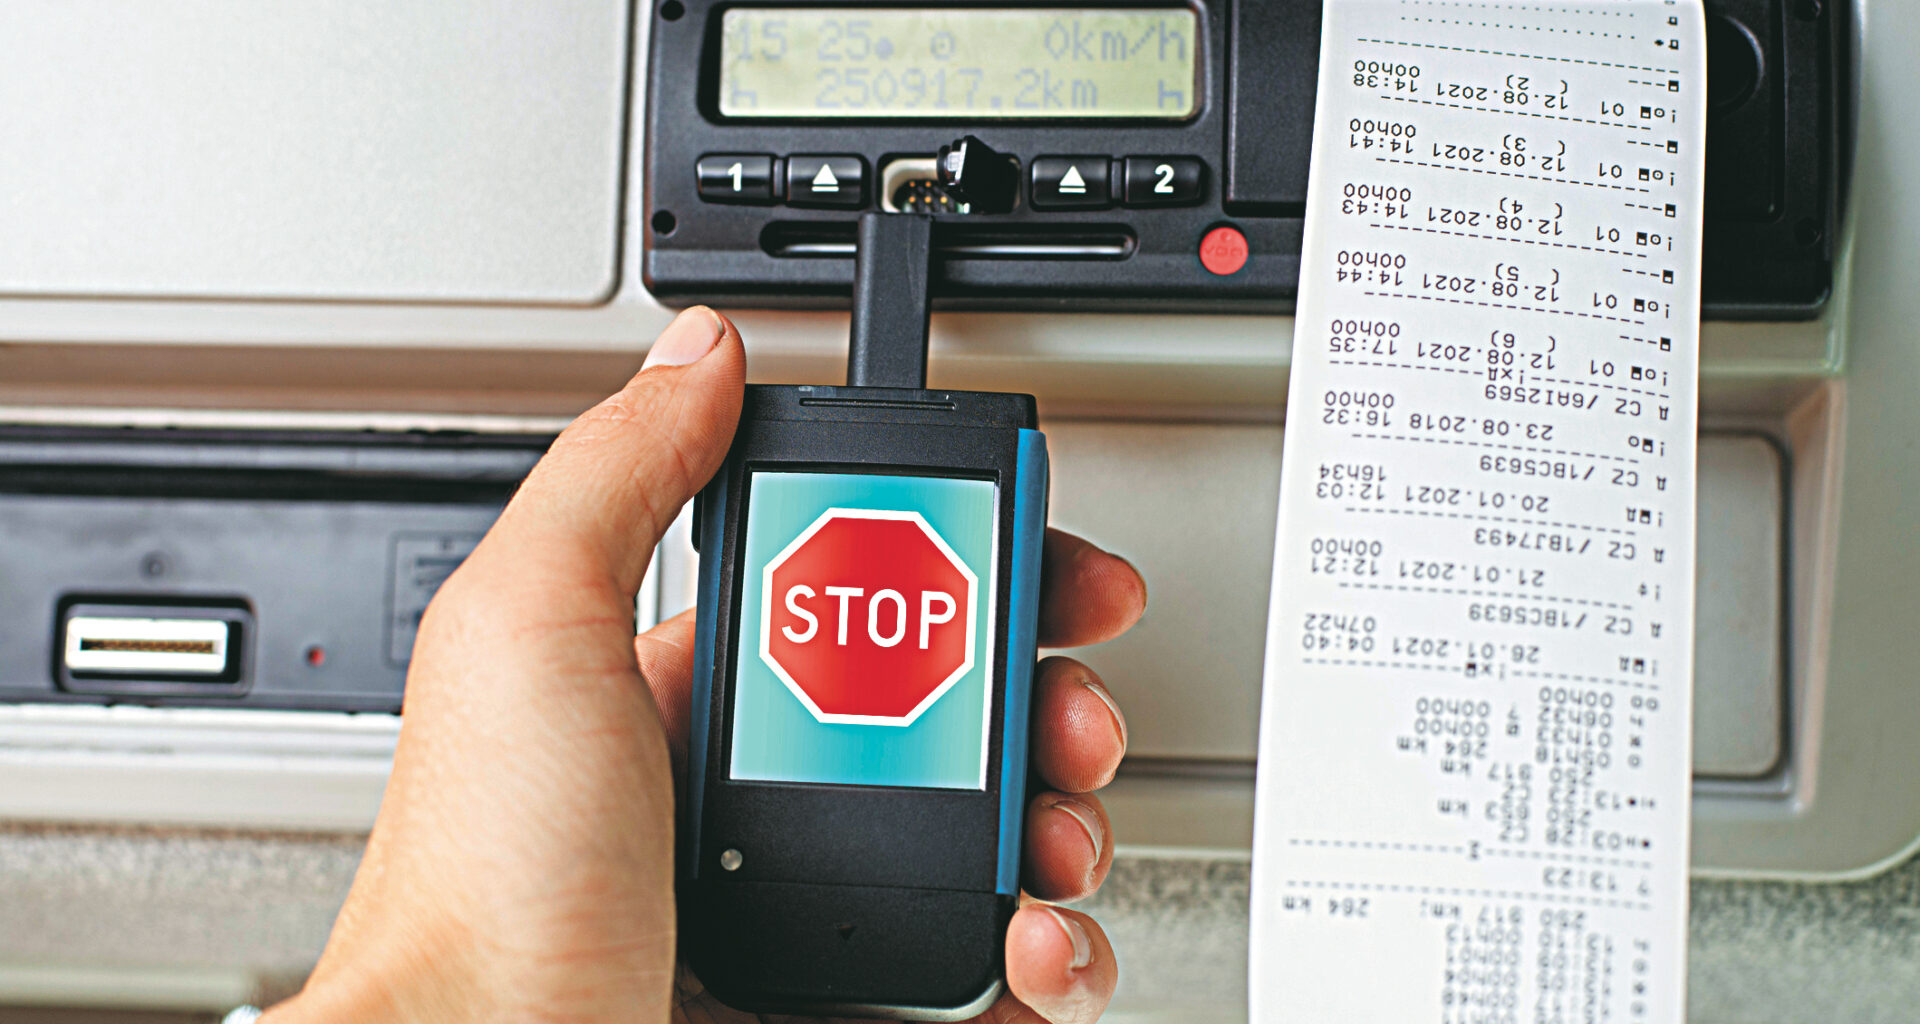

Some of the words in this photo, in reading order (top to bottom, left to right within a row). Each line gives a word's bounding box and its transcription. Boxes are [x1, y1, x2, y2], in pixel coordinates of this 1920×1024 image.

[1044, 20, 1186, 61] 0km/h
[1354, 69, 1418, 92] 14:38
[1355, 60, 1420, 81] 00h00
[1437, 83, 1568, 109] 12.08.2021
[1602, 101, 1624, 116] 01
[1350, 119, 1416, 138] 00h00
[1351, 134, 1413, 153] 14:41
[1433, 143, 1565, 172] 12.08.2021
[727, 162, 743, 192] 1
[1154, 164, 1175, 194] 2
[1599, 163, 1622, 178] 01
[1344, 183, 1411, 202] 00h00
[1342, 196, 1408, 218] 14:43
[1429, 207, 1562, 235] 12.08.2021
[1597, 226, 1619, 242] 01
[1338, 251, 1406, 269] 00h00
[1337, 268, 1402, 286] 14:44
[1424, 274, 1559, 302] 12.08.2021
[1594, 293, 1617, 309] 01
[1331, 320, 1400, 337] 00h00
[1330, 337, 1397, 355] 17:35
[1418, 342, 1555, 370] 12.08.2021
[1591, 360, 1614, 377] 01
[1325, 391, 1394, 409] 00h00
[1615, 398, 1641, 416] CZ
[1323, 406, 1391, 427] 16:32
[1410, 413, 1553, 441] 23.08.2018
[1319, 464, 1386, 482] 16h34
[1612, 469, 1638, 487] CZ
[1316, 481, 1384, 500] 12:03
[1406, 486, 1549, 513] 20.01.2021
[1311, 538, 1382, 557] 00h00
[1608, 541, 1636, 560] CZ
[1312, 556, 1378, 576] 12:21
[1400, 561, 1544, 587] 21.01.2021
[781, 584, 957, 650] STOP
[1304, 613, 1376, 634] 07h22
[1604, 615, 1632, 635] CZ
[1302, 632, 1374, 653] 04:40
[1393, 637, 1540, 664] 26.01.2021
[1539, 686, 1614, 710] 00h00
[1397, 738, 1426, 752] km
